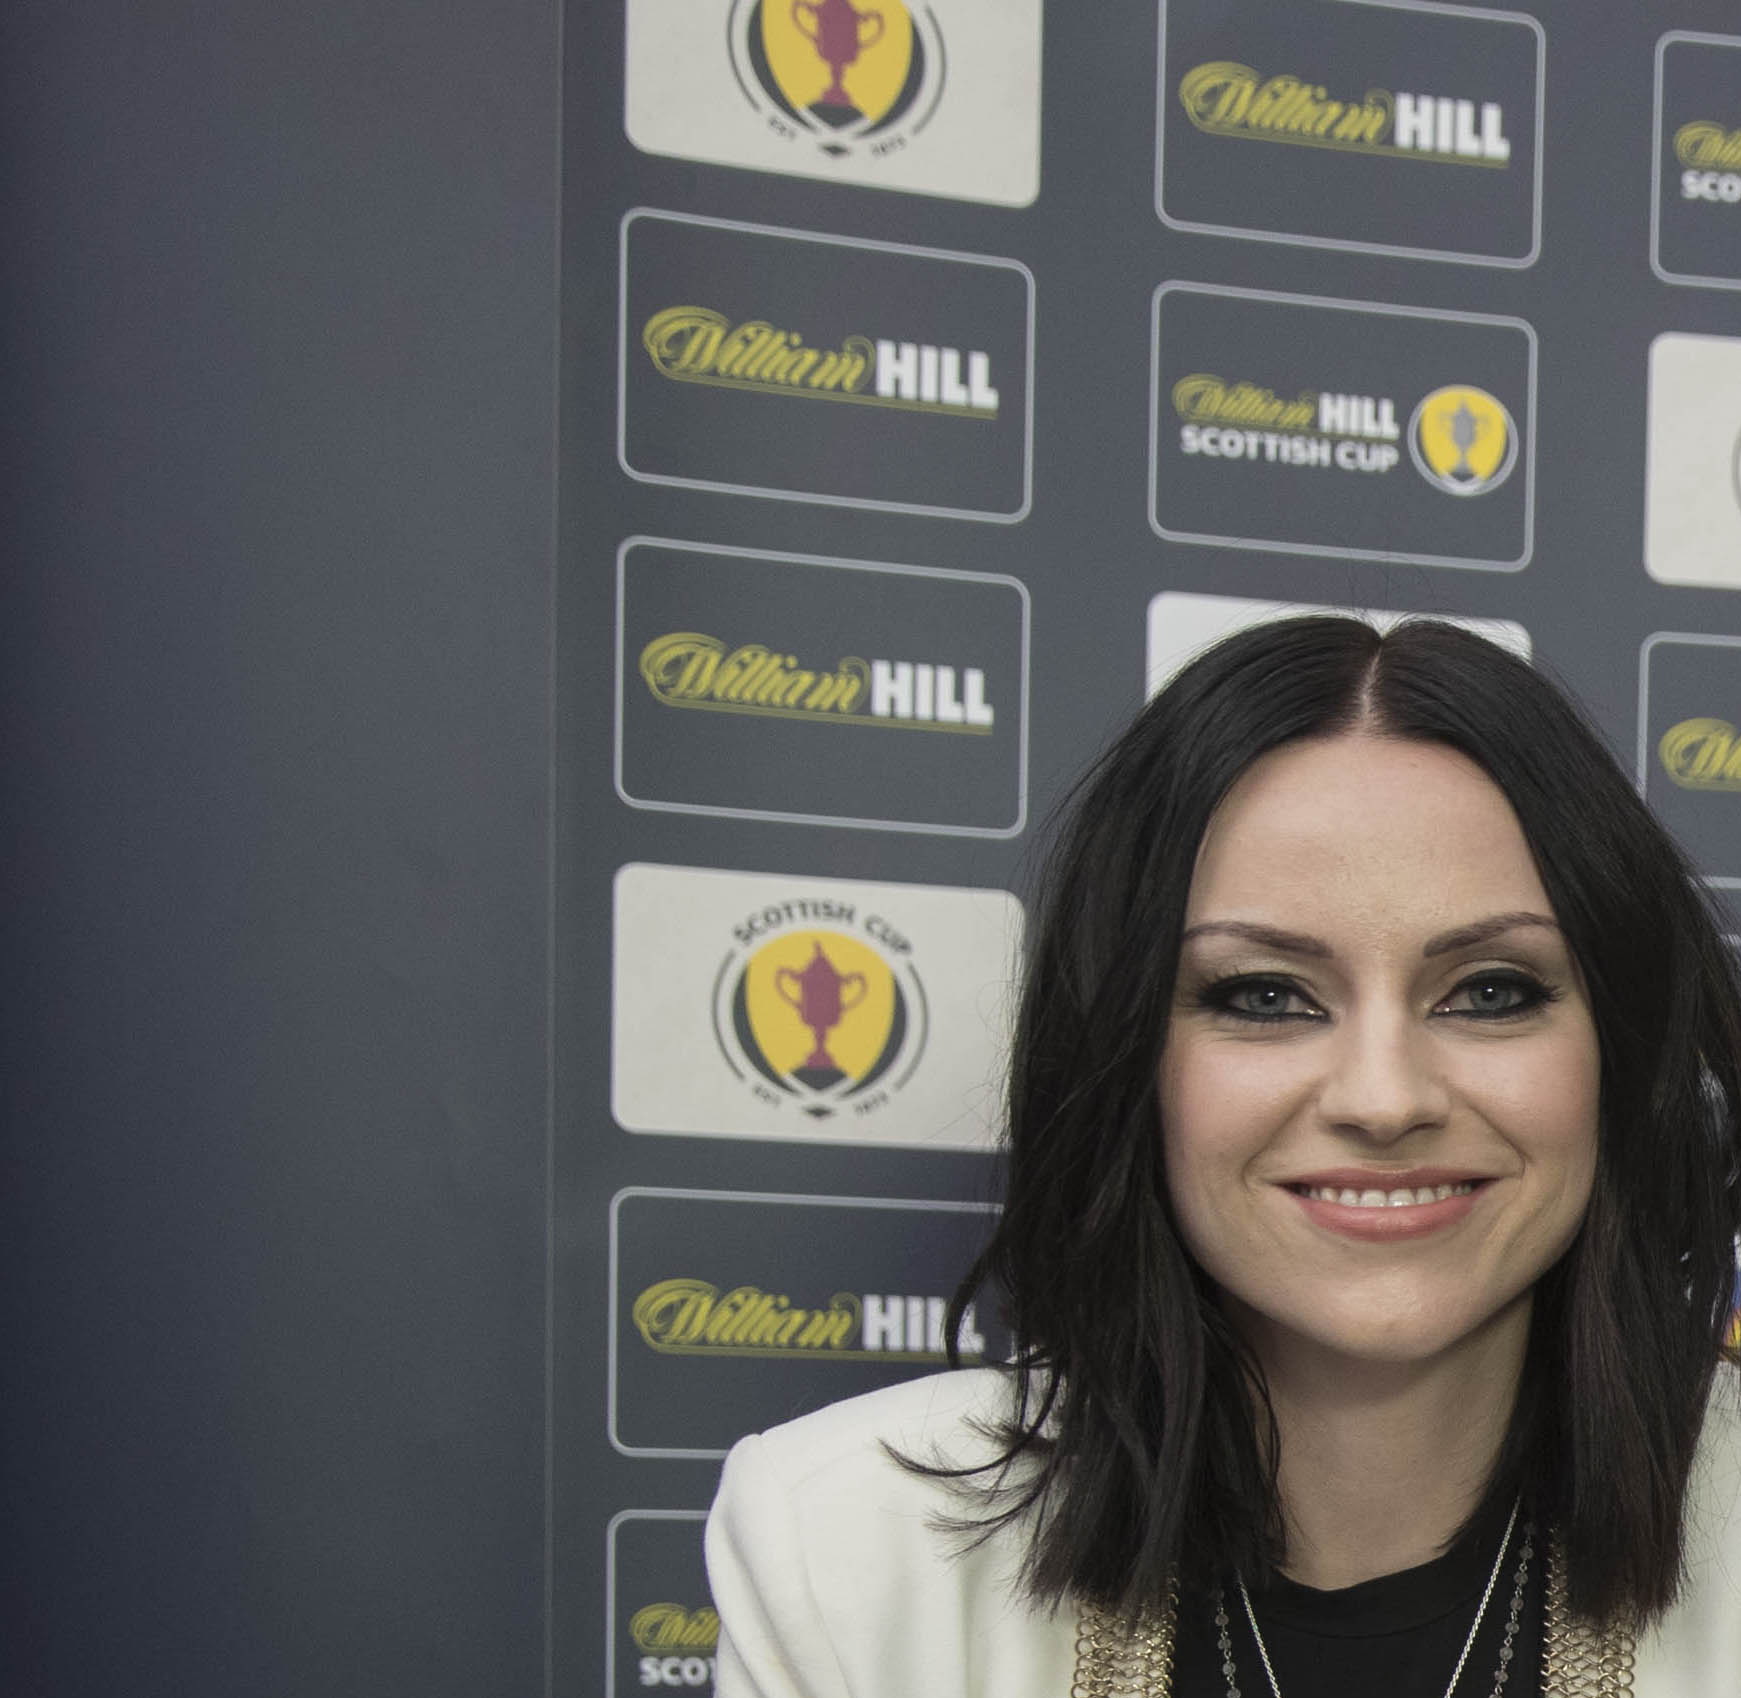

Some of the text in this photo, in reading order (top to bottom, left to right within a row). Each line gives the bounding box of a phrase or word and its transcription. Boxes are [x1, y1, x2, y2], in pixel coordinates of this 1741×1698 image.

[1179, 61, 1510, 159] William HILL
[643, 305, 999, 410] William HILL
[1172, 373, 1400, 439] William HILL
[1180, 425, 1400, 472] SCOTTISH CUP
[640, 631, 995, 726] William HILL
[733, 899, 913, 959] SCOTTISH CUP
[632, 1278, 861, 1356] William
